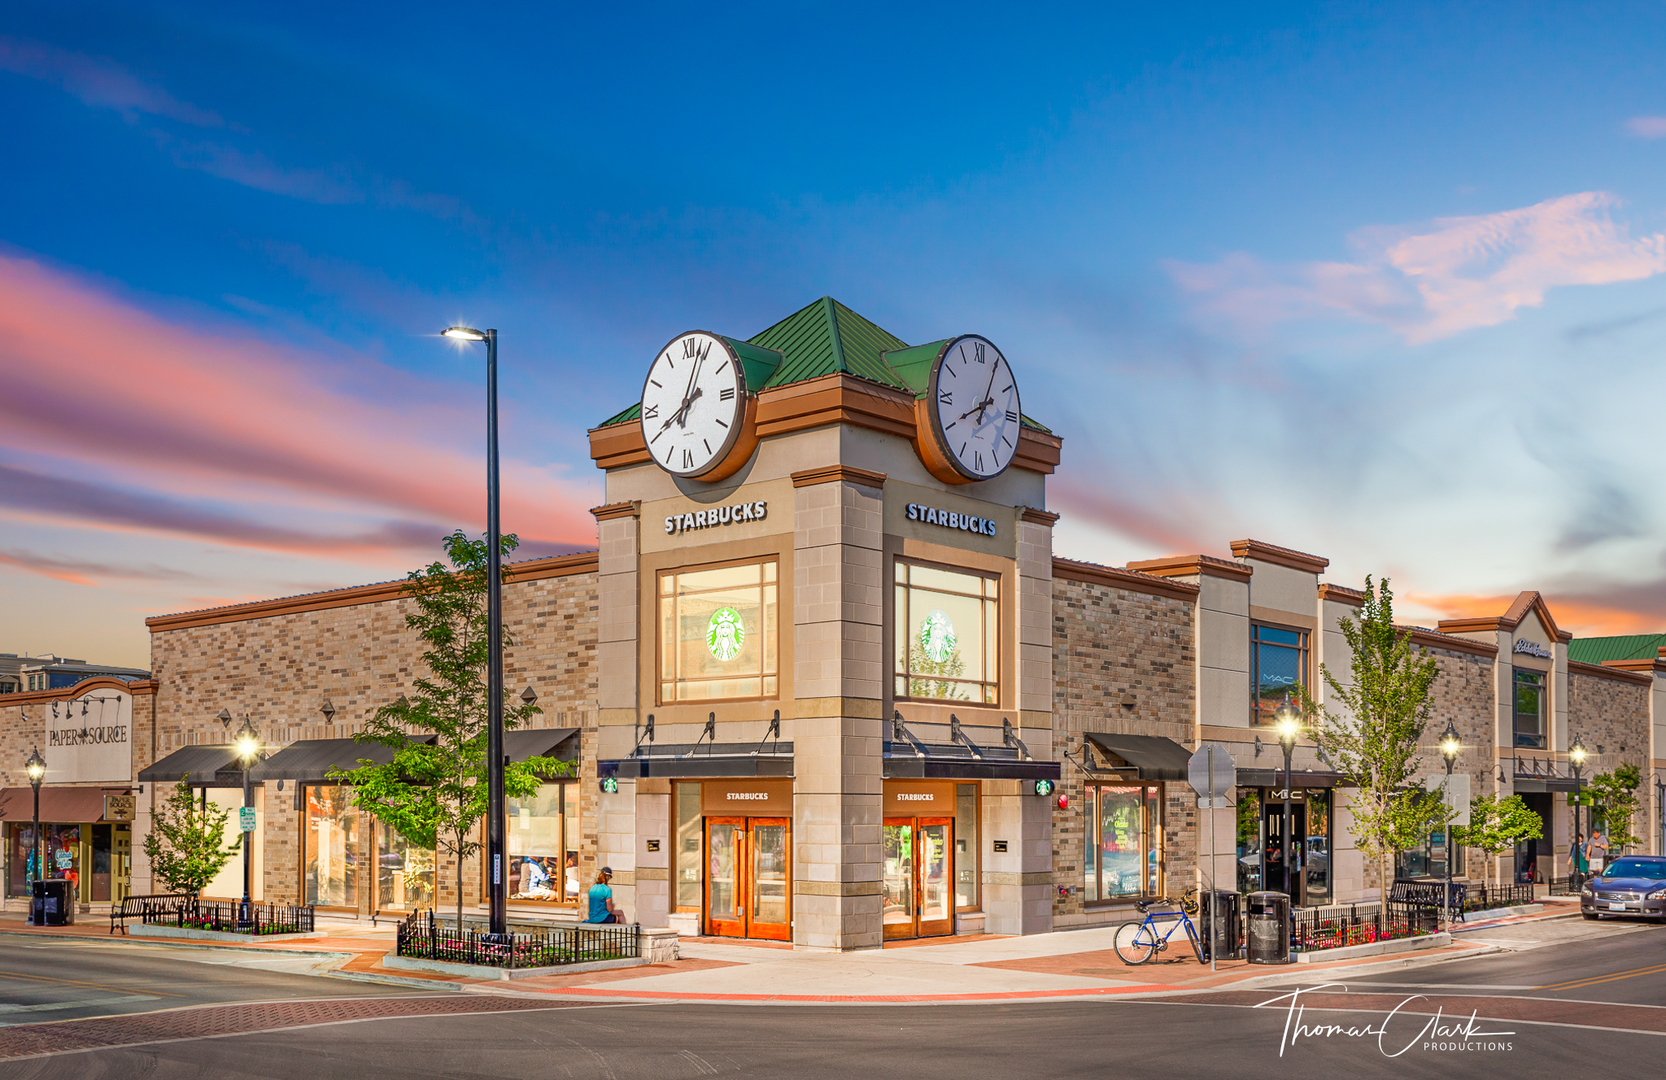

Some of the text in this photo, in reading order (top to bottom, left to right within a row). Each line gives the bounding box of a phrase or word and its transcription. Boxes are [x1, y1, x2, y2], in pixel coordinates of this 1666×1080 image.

[682, 337, 695, 360] XII
[974, 342, 985, 364] XII
[720, 387, 734, 401] III
[1006, 410, 1017, 423] III
[664, 501, 766, 533] STARBUCKS
[907, 502, 996, 536] STARBUCKS
[49, 725, 127, 746] PAPER SOURCE
[726, 792, 769, 800] STARBUCKS
[897, 793, 934, 801] STARBUCKS
[1271, 790, 1302, 799] MC
